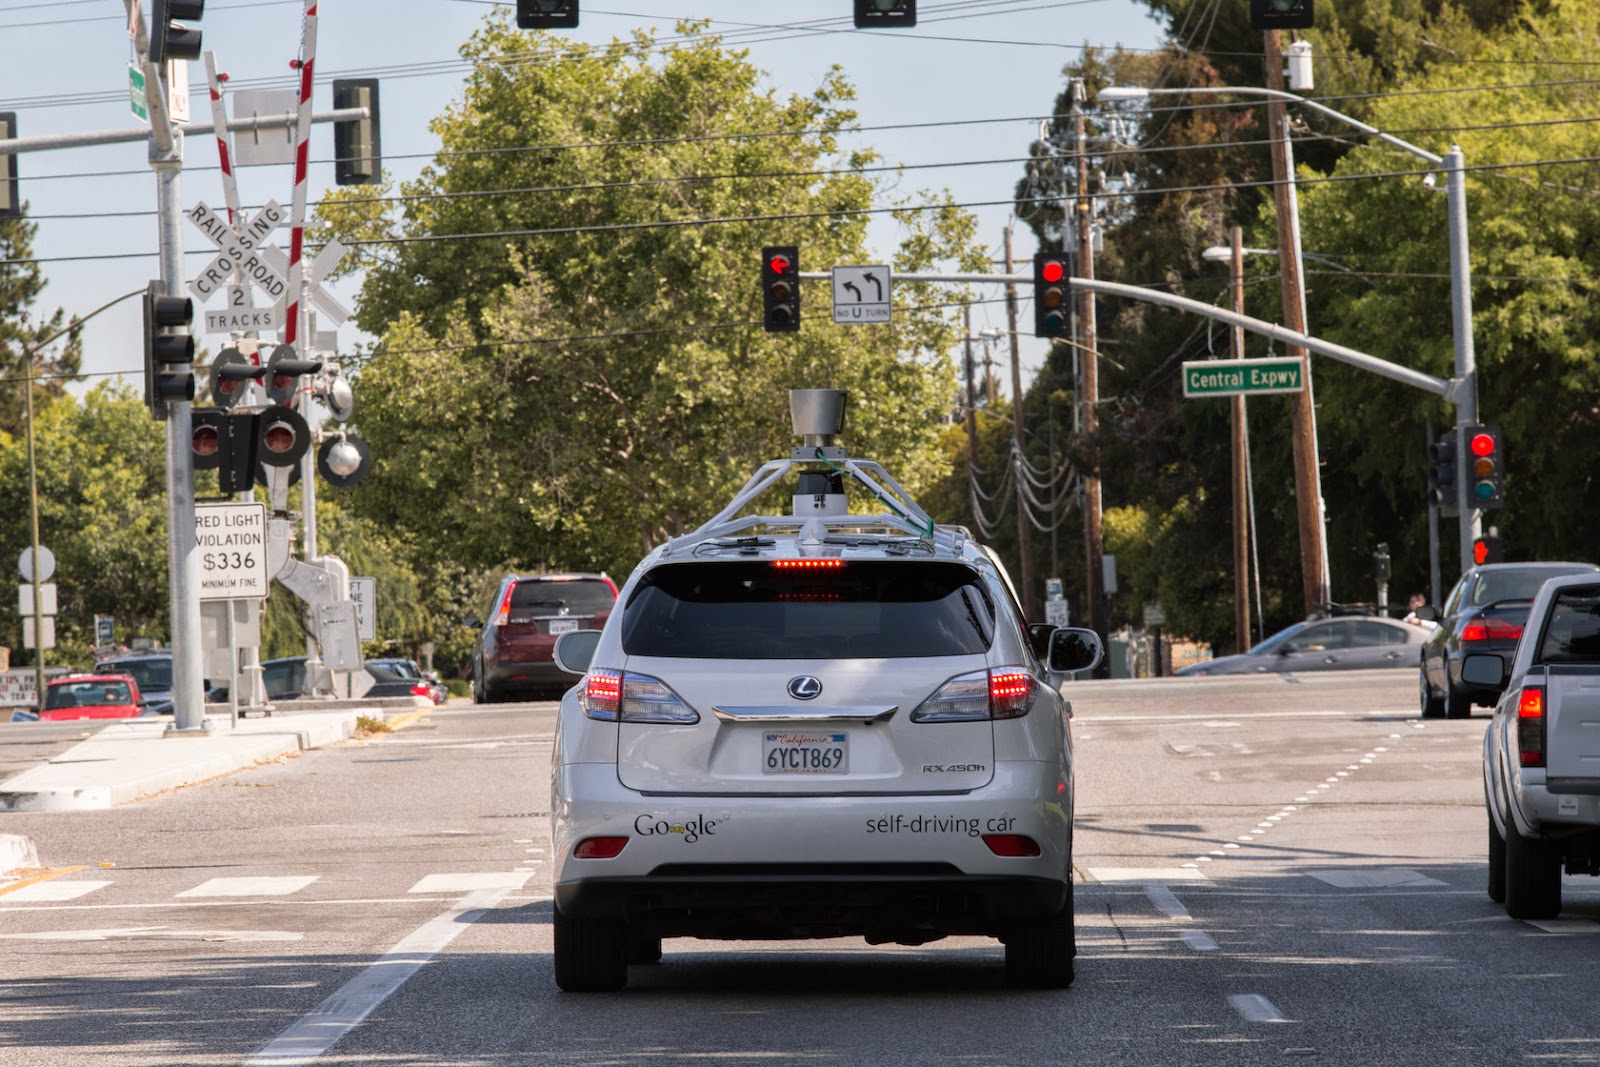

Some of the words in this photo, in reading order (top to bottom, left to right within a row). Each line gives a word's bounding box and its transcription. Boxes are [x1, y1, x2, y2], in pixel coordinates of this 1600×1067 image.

[192, 206, 227, 245] RAIL
[244, 256, 284, 296] ROAD
[197, 208, 279, 294] CROSSING
[232, 289, 245, 306] 2
[208, 313, 272, 328] TRACKS
[852, 307, 861, 318] U
[866, 309, 888, 317] TURN
[1190, 370, 1243, 388] Central
[1251, 369, 1297, 387] Expwy
[195, 515, 220, 528] RED
[225, 514, 261, 527] LIGHT
[195, 532, 261, 546] VIOLATION
[203, 551, 255, 572] $336
[201, 579, 236, 589] MINIMUM
[239, 577, 258, 588] FINE
[780, 733, 832, 747] California
[767, 747, 843, 769] 6YCT869
[922, 764, 945, 773] RX
[946, 763, 985, 773] 450h
[866, 814, 981, 838] self-driving
[986, 816, 1017, 832] car
